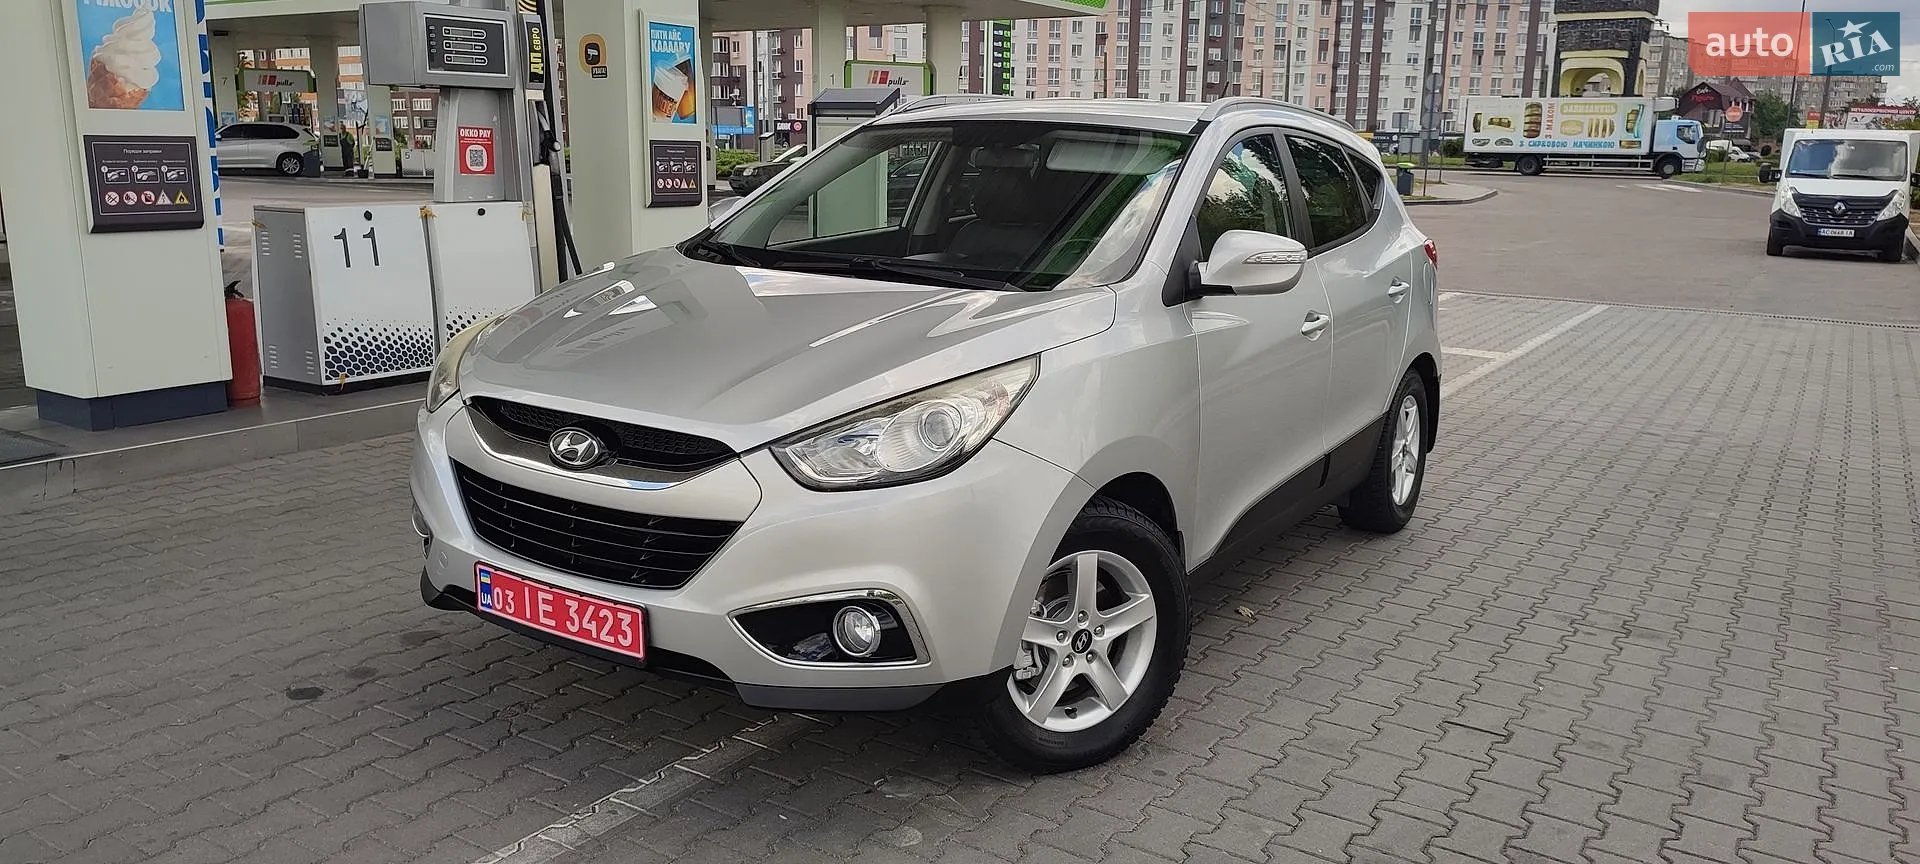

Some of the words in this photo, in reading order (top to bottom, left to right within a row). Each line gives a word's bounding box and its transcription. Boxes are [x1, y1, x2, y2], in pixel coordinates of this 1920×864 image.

[531, 27, 542, 51] ЄВРО
[530, 52, 543, 75] ДП
[221, 77, 228, 86] 7
[460, 128, 478, 138] OKKO
[479, 129, 491, 138] PAY
[404, 151, 411, 160] 5
[333, 227, 380, 268] 11
[481, 593, 493, 607] UA
[493, 587, 516, 615] 03
[524, 586, 556, 627] IE
[565, 598, 634, 648] 3423
